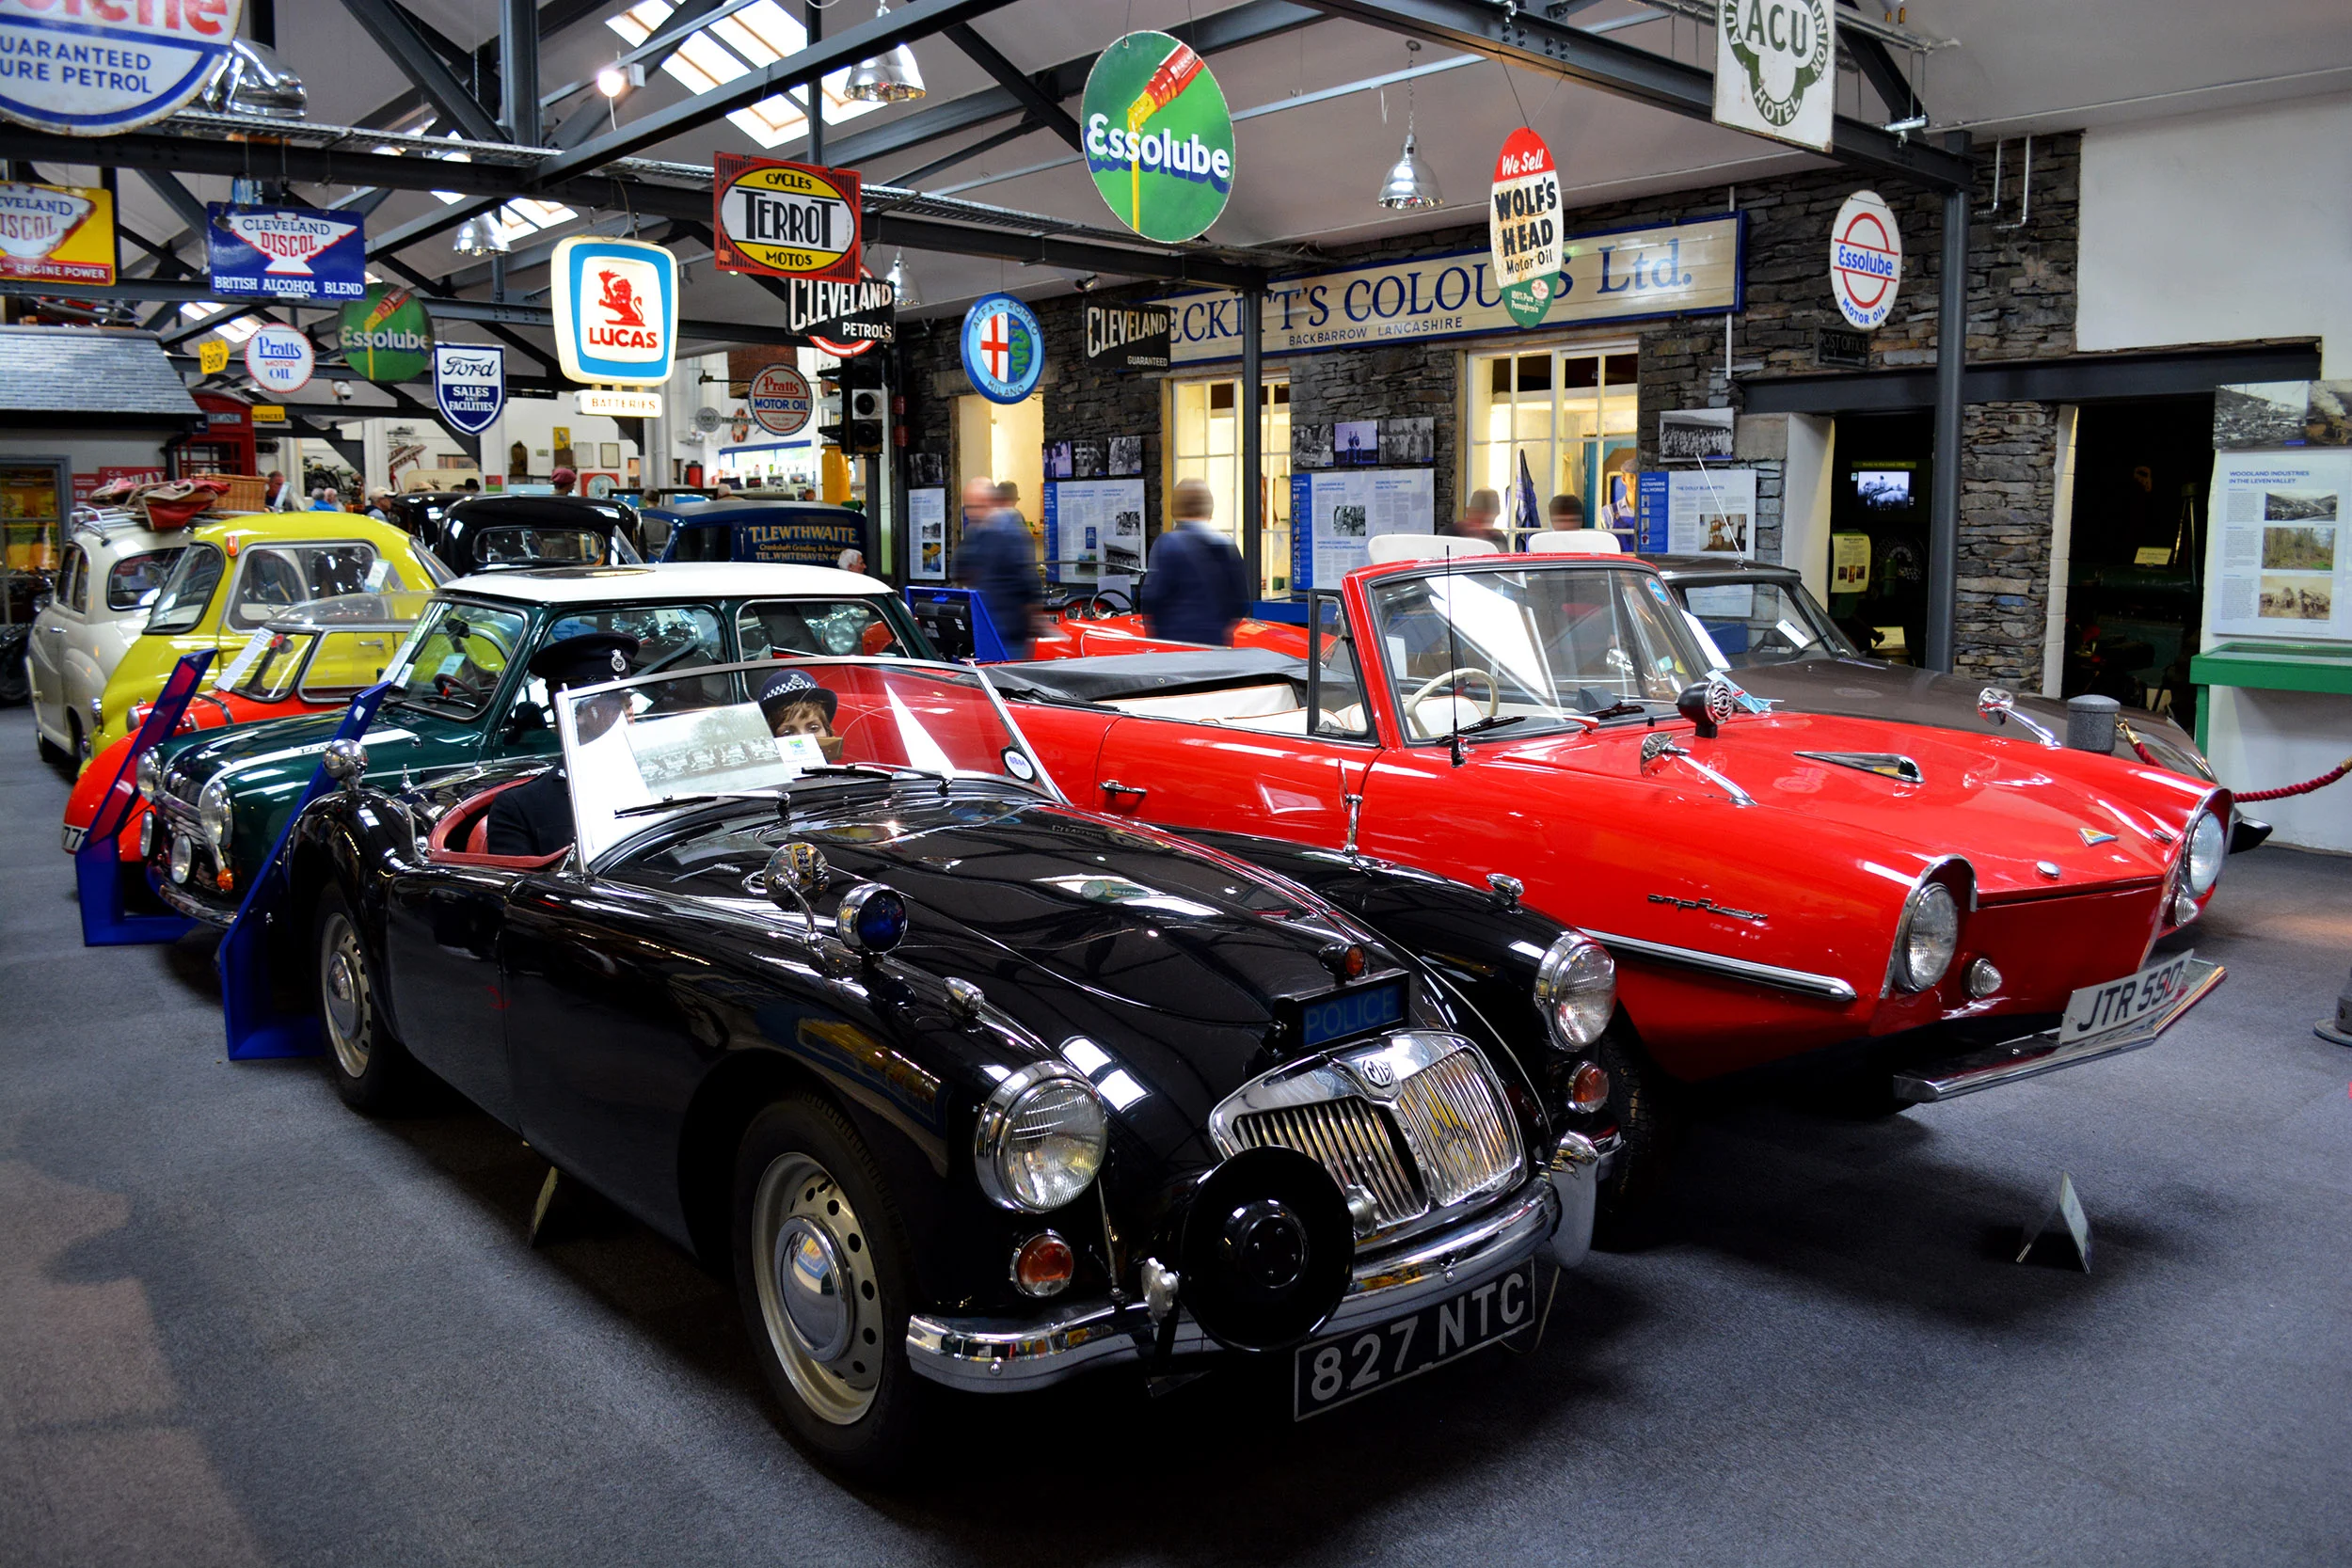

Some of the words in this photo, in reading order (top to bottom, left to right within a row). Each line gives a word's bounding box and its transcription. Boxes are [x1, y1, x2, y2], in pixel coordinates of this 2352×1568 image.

[1744, 0, 1807, 58] ACU
[1810, 0, 1827, 76] UNION
[0, 37, 151, 71] UARANTEED
[0, 58, 51, 81] URE
[63, 66, 152, 94] PETROL
[1754, 87, 1801, 124] HOTEL
[1087, 113, 1231, 178] Essolube
[1502, 154, 1519, 176] We
[1520, 149, 1544, 172] Sell
[766, 173, 813, 190] CYCLES
[0, 196, 73, 216] VELAND
[1494, 177, 1557, 222] WOLF'S
[0, 214, 57, 241] ISCOL
[243, 219, 330, 235] CLEVELAND
[736, 189, 840, 248] TERROT
[261, 232, 317, 257] DISCOL
[1502, 218, 1554, 258] HEAD
[16, 264, 61, 276] ENGINE
[64, 269, 106, 279] POWER
[766, 251, 813, 267] MOTOS
[1506, 258, 1534, 276] Motor
[1537, 248, 1553, 265] Oil
[1597, 238, 1692, 294] Ltd.
[1838, 245, 1893, 276] Essolube
[215, 276, 258, 290] BRITISH
[262, 279, 317, 293] ALCOHOL
[325, 282, 364, 295] BLEND
[790, 277, 893, 332] CLEVELAND
[1842, 298, 1870, 325] MOTOR
[1873, 306, 1885, 321] OIL
[842, 322, 892, 339] PETROLS
[973, 305, 995, 330] ALFA
[1009, 301, 1040, 336] ROMEO
[1289, 327, 1368, 346] BACKBARROW
[1377, 317, 1463, 337] LANCASHIRE
[340, 325, 432, 350] Essolube
[589, 327, 658, 348] LUCAS
[1088, 307, 1168, 358] CLEVELAND
[257, 336, 302, 358] Pratts
[269, 368, 293, 379] OIL
[442, 356, 497, 376] Ford
[1127, 356, 1168, 367] GUARANTEED
[453, 386, 490, 397] SALES
[763, 375, 800, 393] Pratts
[988, 380, 1025, 398] MILANO
[449, 401, 495, 412] FACILITIES
[592, 398, 656, 410] BATTERIES
[755, 399, 788, 411] MOTOR
[792, 399, 808, 411] OIL
[64, 826, 88, 848] 77
[1305, 988, 1394, 1041] POLICE
[2077, 981, 2137, 1032] JTR
[1368, 1061, 1391, 1083] MG
[1311, 1316, 1419, 1402] 827
[1438, 1273, 1524, 1356] NTC
